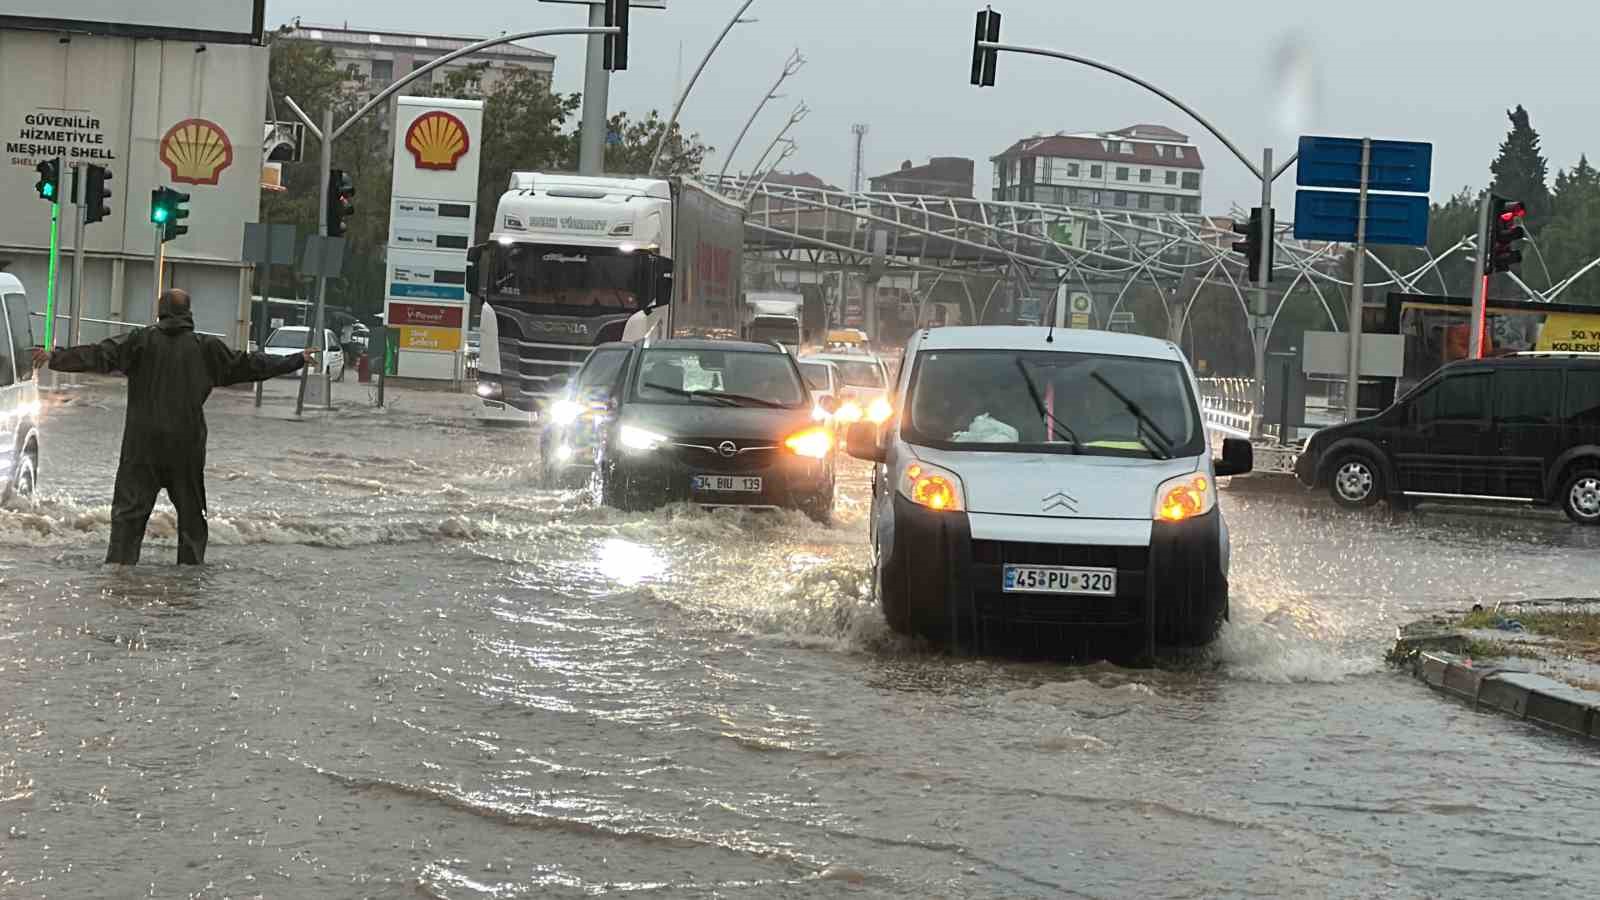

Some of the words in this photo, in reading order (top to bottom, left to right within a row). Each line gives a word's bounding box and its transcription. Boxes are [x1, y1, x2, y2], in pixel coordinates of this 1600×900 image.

[25, 113, 100, 129] GÜVENİLİR
[20, 127, 104, 144] HİZMETİYLE
[6, 142, 66, 156] MEŞHUR
[70, 146, 116, 160] SHELL
[743, 478, 761, 490] 139
[1016, 570, 1037, 588] 45
[1048, 571, 1069, 589] PU
[1081, 573, 1112, 591] 320
